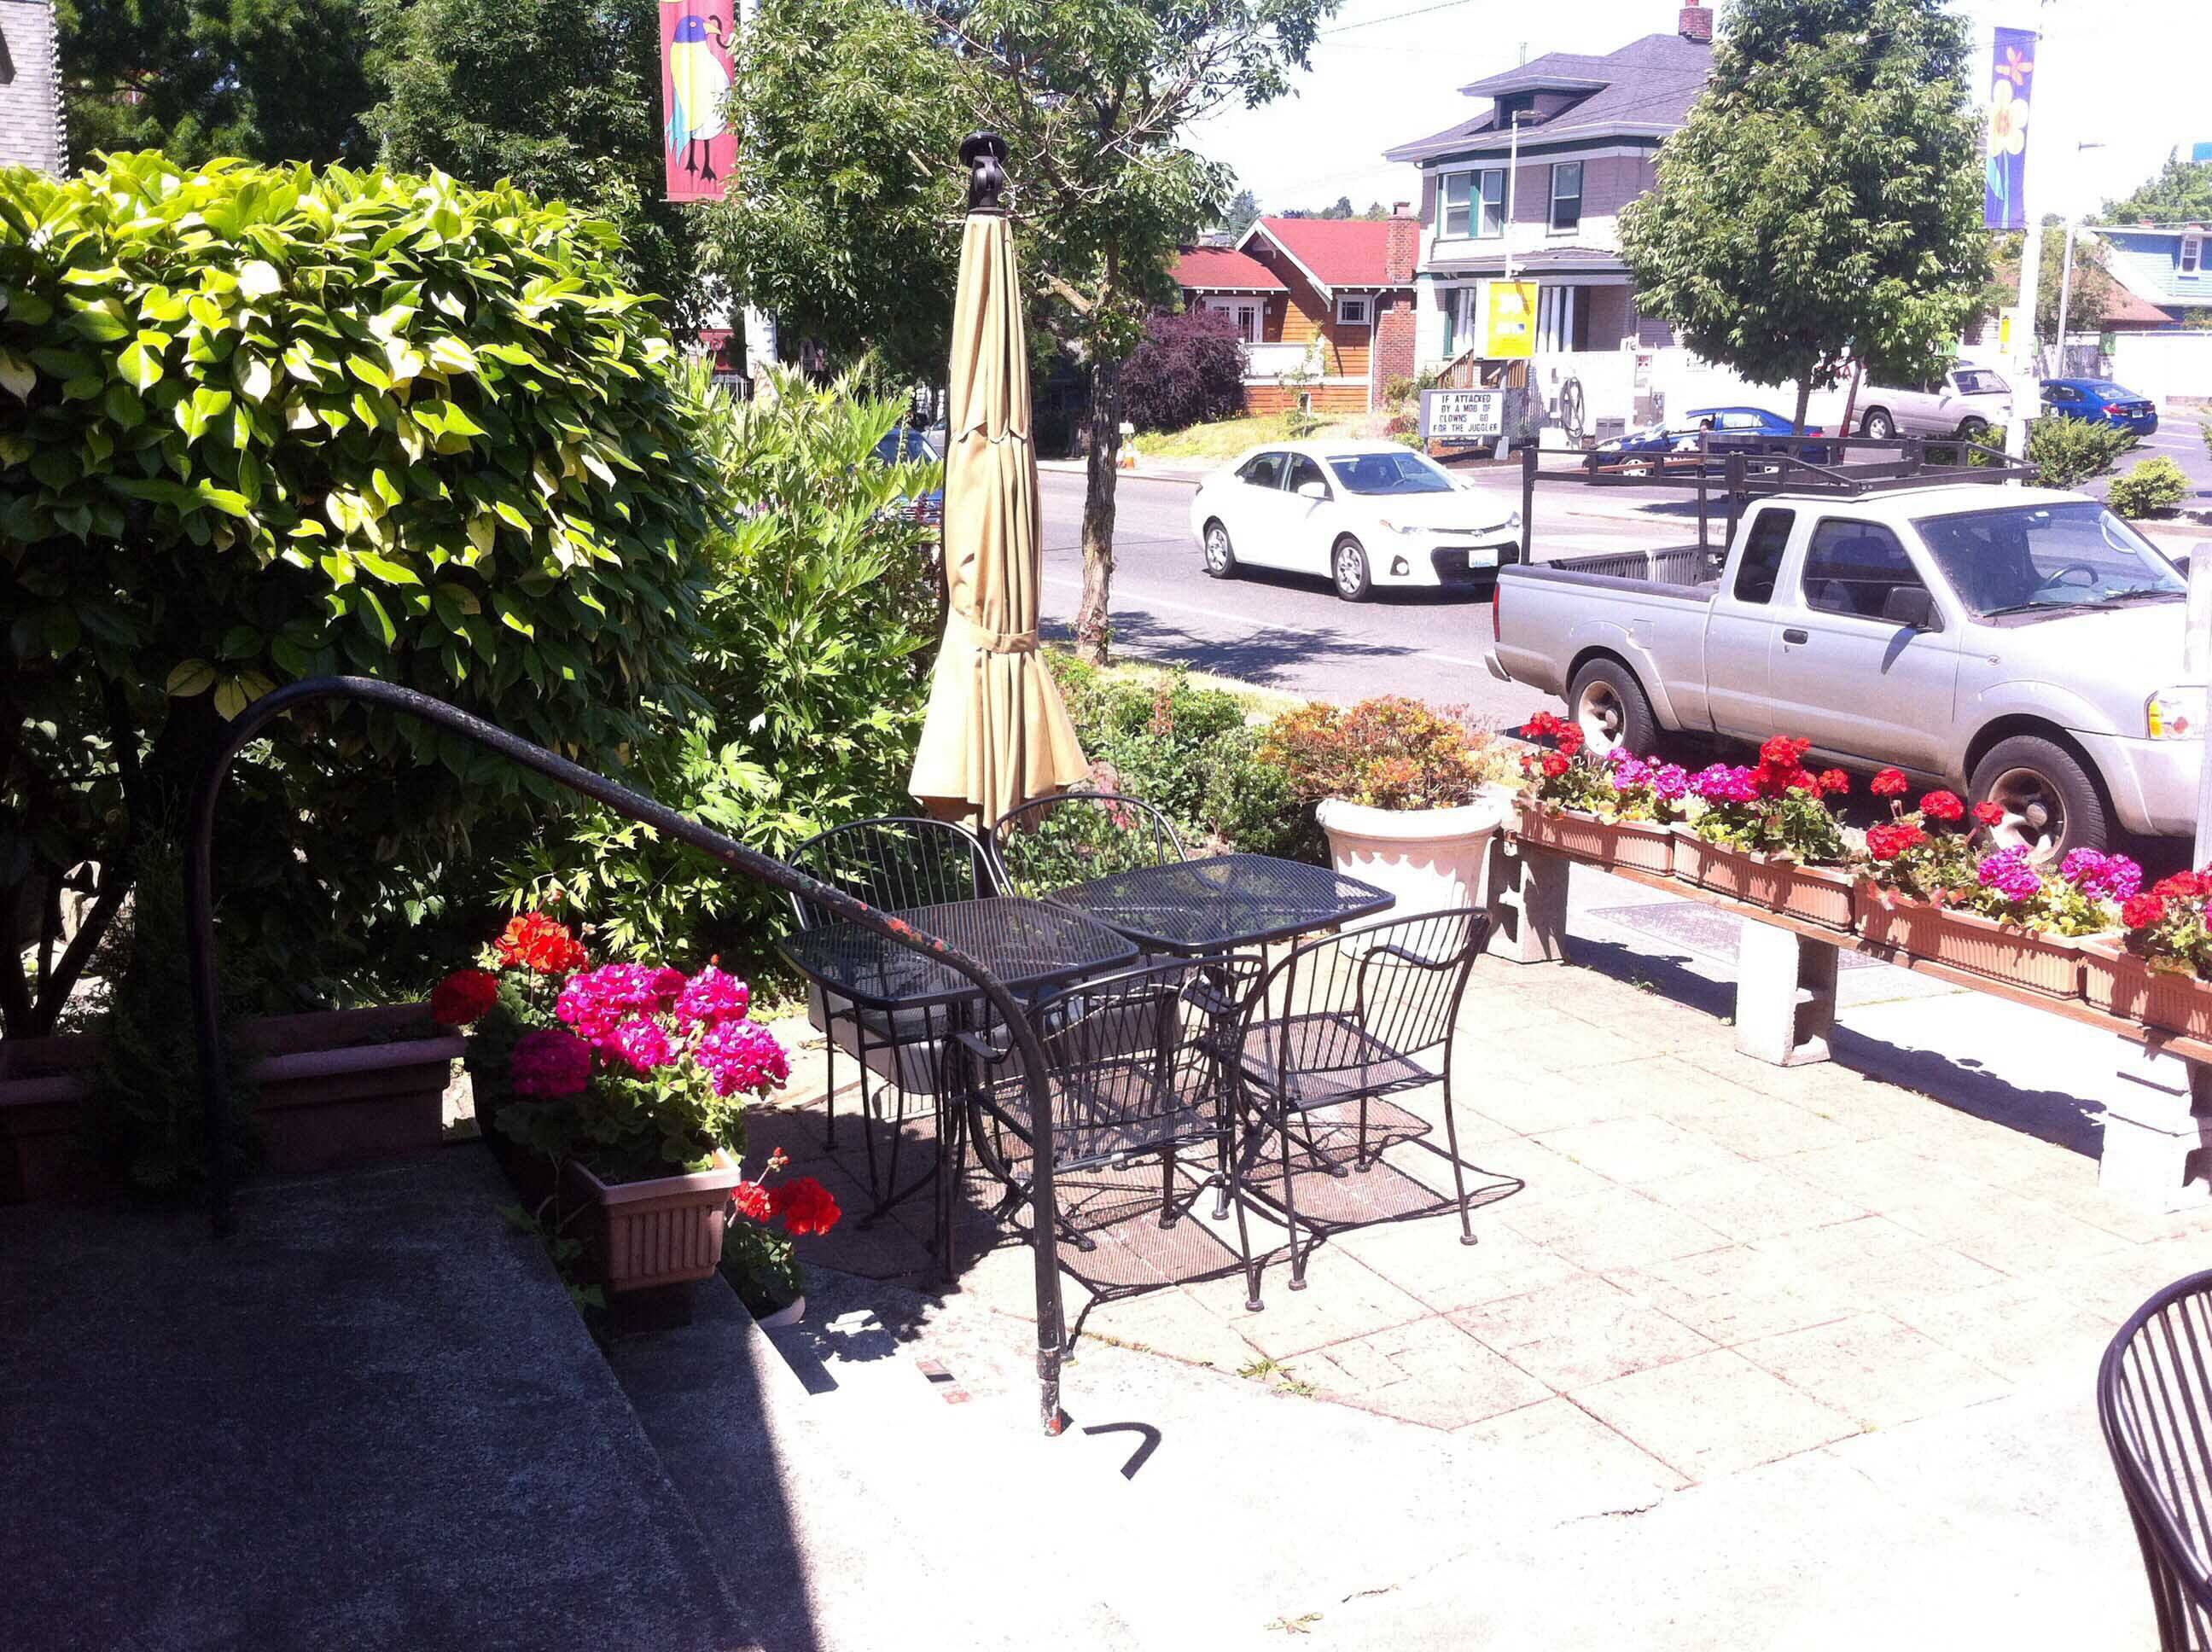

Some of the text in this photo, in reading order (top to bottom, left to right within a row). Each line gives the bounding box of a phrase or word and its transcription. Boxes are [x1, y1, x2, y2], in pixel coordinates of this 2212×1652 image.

[1442, 394, 1491, 404] IF ATTACKED
[1440, 414, 1467, 422] CLOWNS
[1468, 423, 1498, 432] JUGGLER
